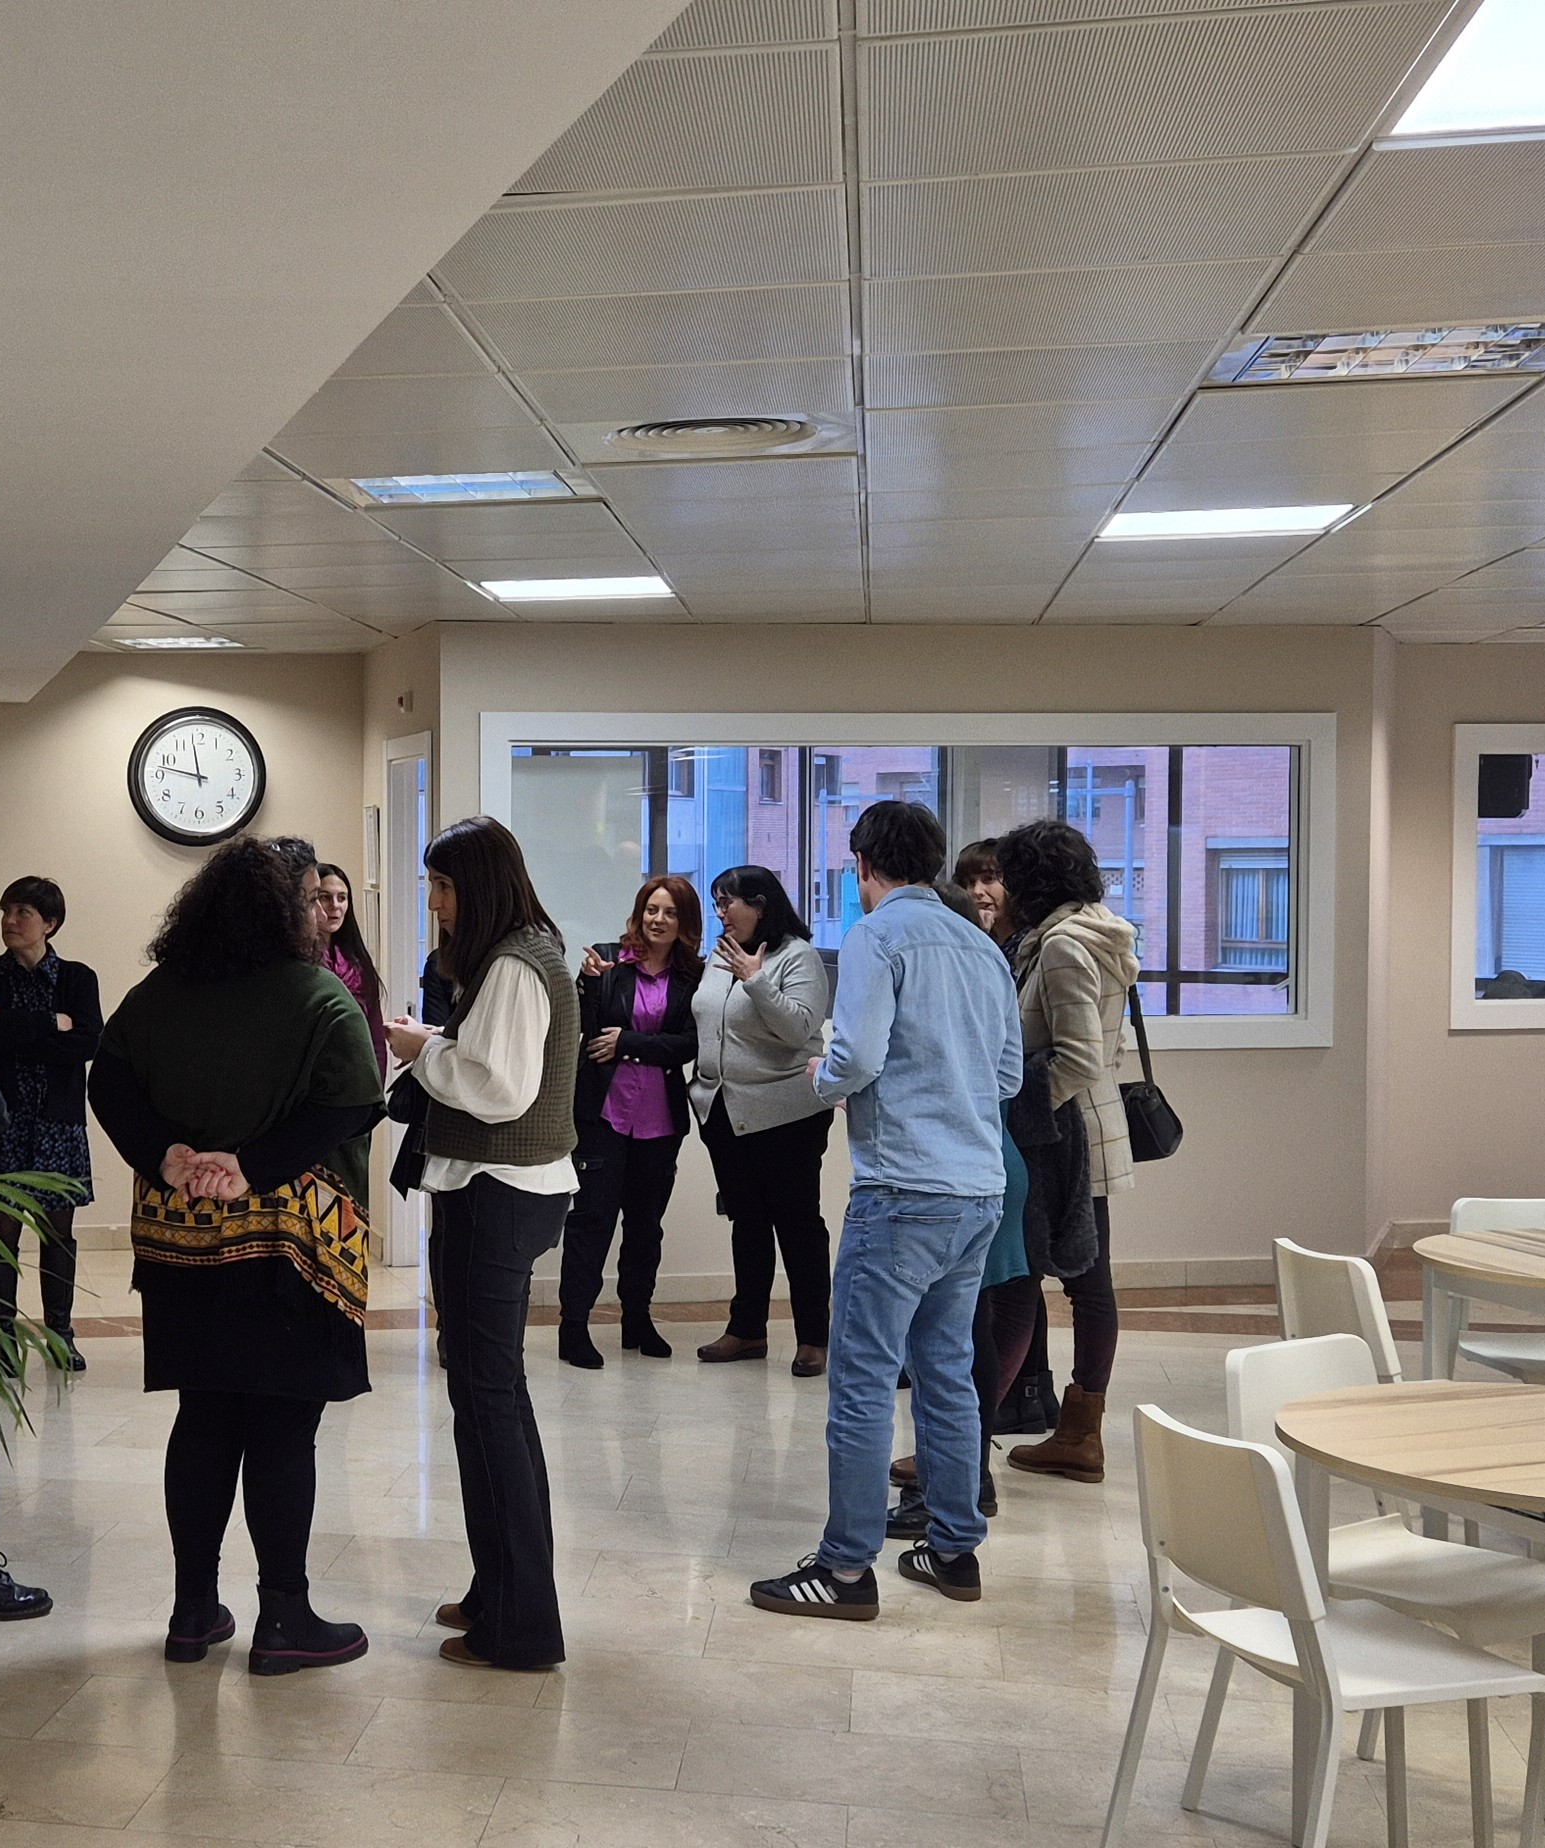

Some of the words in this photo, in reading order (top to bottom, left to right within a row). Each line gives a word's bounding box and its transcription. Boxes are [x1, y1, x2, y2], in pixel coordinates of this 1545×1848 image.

[175, 739, 186, 751] 11
[191, 732, 205, 745] 12
[214, 738, 218, 750] 1
[162, 753, 176, 766] 10
[225, 749, 234, 761] 2
[155, 770, 165, 784] 9
[234, 768, 242, 781] 3
[161, 789, 171, 802] 8
[227, 786, 236, 798] 4
[178, 802, 186, 814] 7
[194, 806, 204, 819] 6
[215, 800, 224, 814] 5
